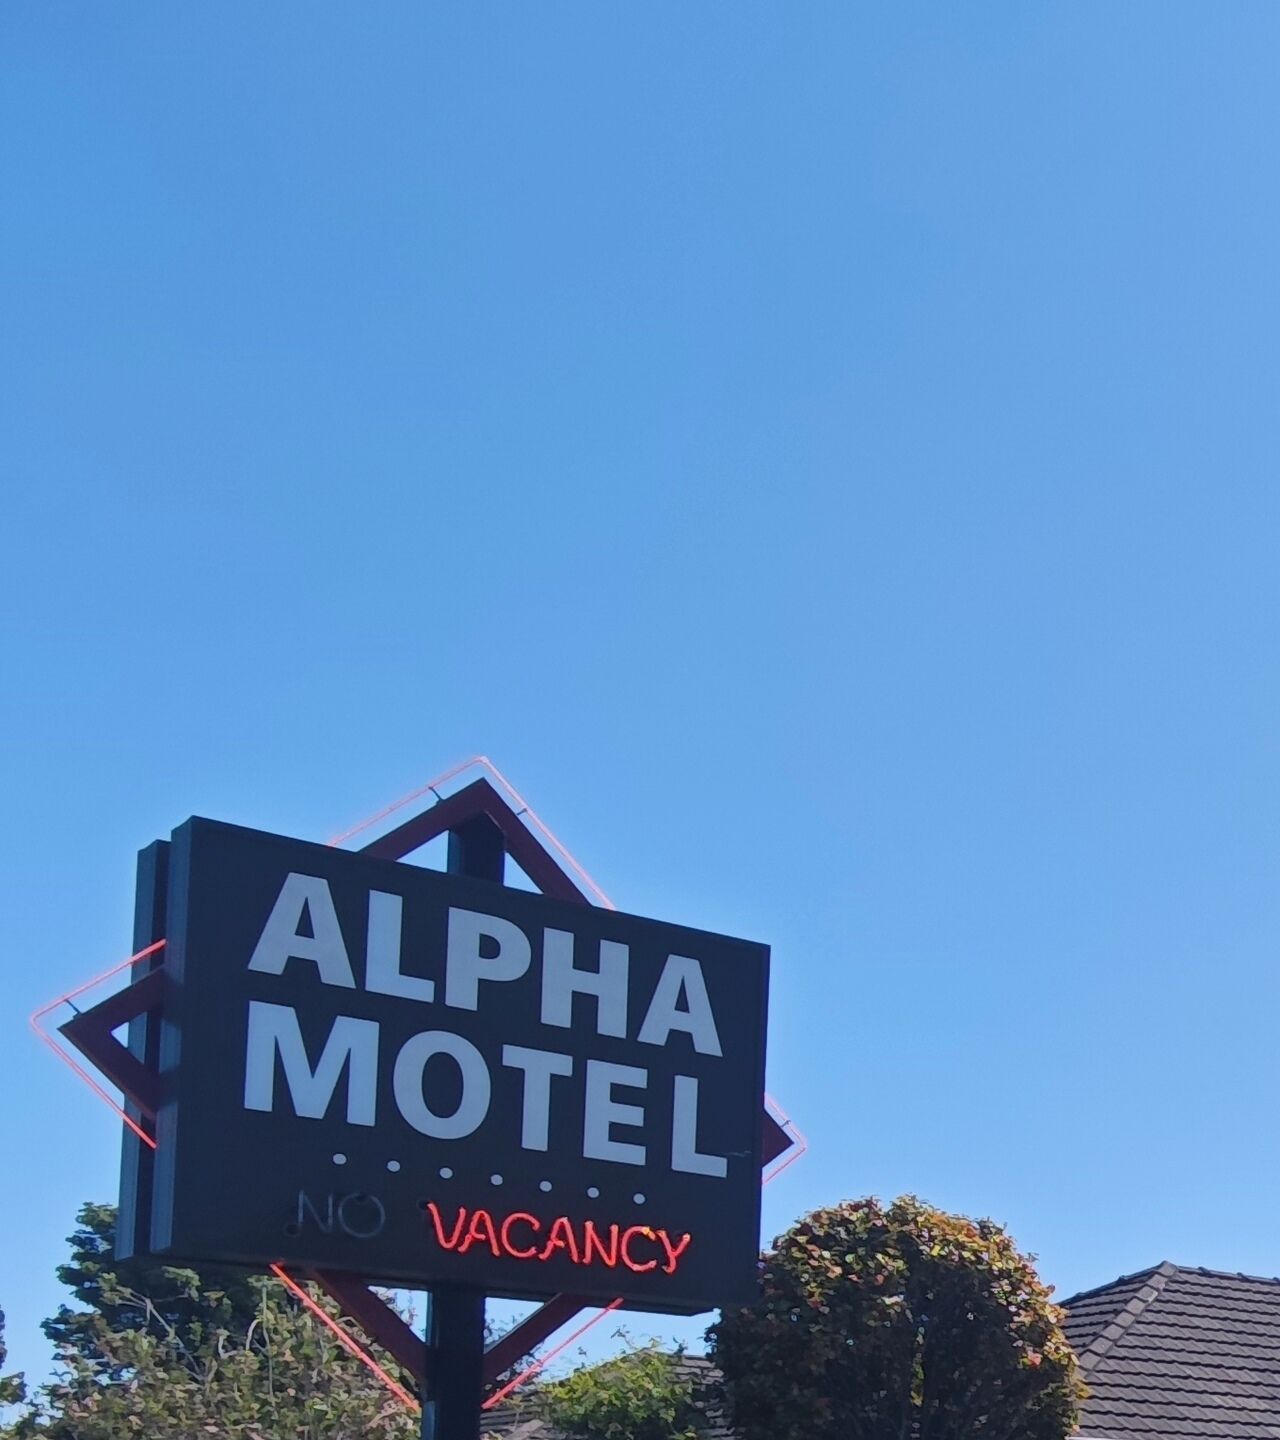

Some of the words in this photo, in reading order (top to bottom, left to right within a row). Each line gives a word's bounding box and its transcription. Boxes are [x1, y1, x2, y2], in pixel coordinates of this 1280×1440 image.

[247, 871, 723, 1058] ALPHA
[243, 1000, 729, 1178] MOTEL
[290, 1189, 386, 1239] NO
[426, 1201, 691, 1275] VACANCY
